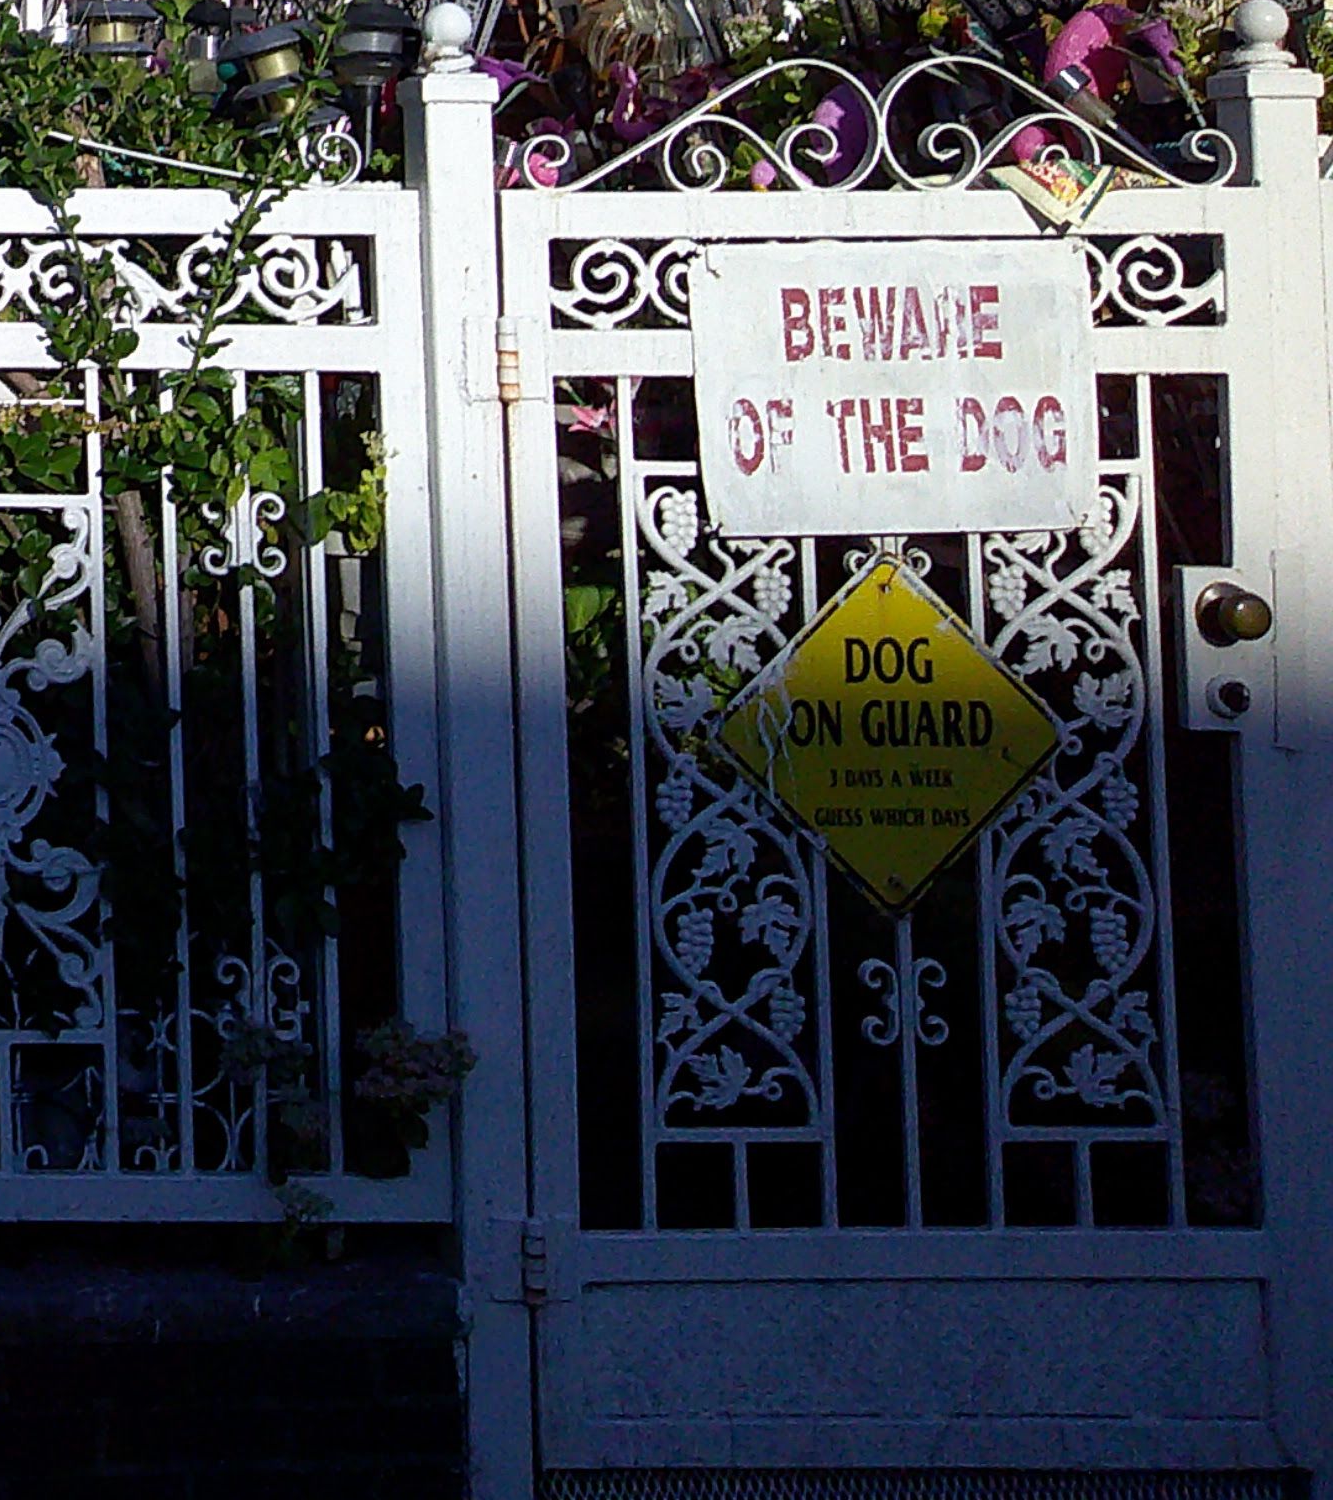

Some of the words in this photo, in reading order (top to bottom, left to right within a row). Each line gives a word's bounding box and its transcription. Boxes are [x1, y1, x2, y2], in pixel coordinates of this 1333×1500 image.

[781, 286, 1003, 362] BEWARE
[729, 397, 794, 475] OF
[826, 397, 930, 474] THE
[957, 396, 1068, 474] DOG
[844, 637, 933, 684] DOG
[788, 699, 843, 747] ON
[860, 699, 994, 748] GUARD
[845, 768, 884, 789] DAYS
[890, 768, 903, 789] A
[909, 768, 953, 789] WEEK
[813, 807, 864, 828] GUESS
[870, 807, 925, 828] WHICH
[932, 807, 971, 828] DAYS
